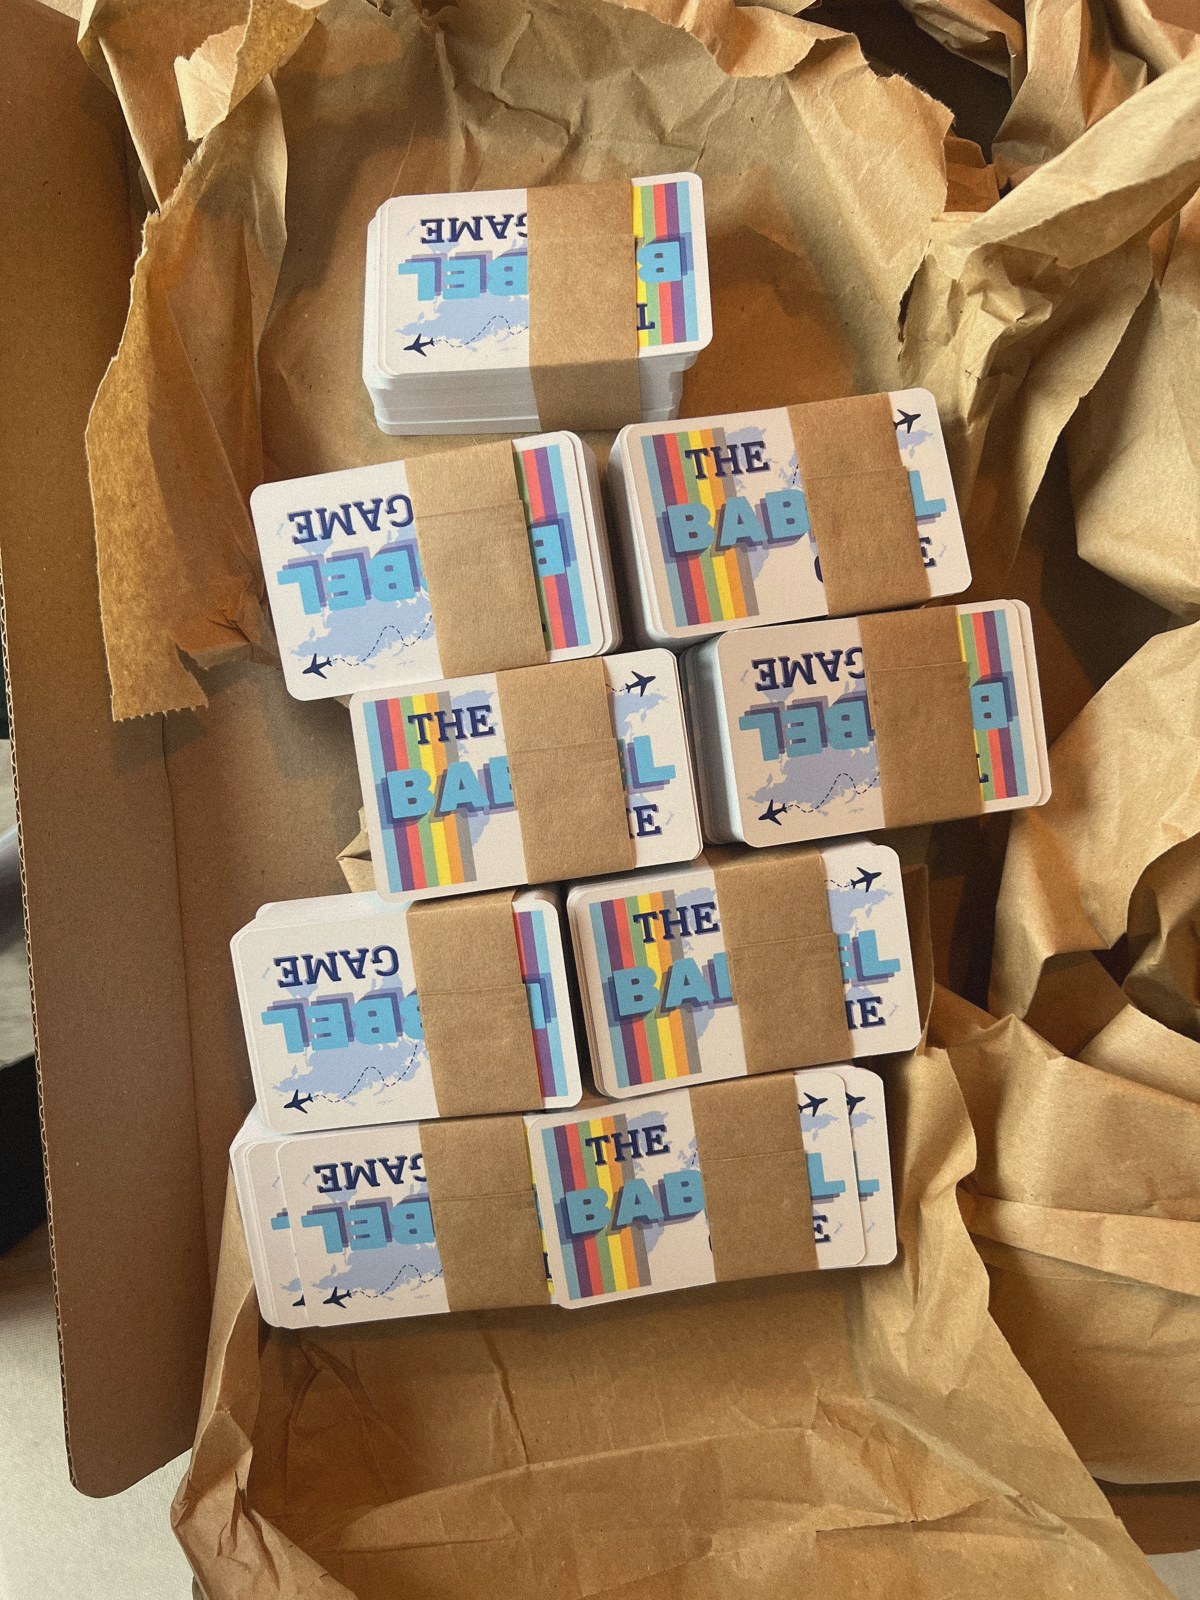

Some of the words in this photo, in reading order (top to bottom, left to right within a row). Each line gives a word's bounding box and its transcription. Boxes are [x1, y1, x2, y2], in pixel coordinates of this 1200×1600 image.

[685, 440, 770, 481] THE
[287, 493, 415, 545] GAME
[407, 703, 496, 746] THE
[632, 901, 721, 944] THE
[274, 944, 401, 989] GAME
[585, 1124, 671, 1167] THE
